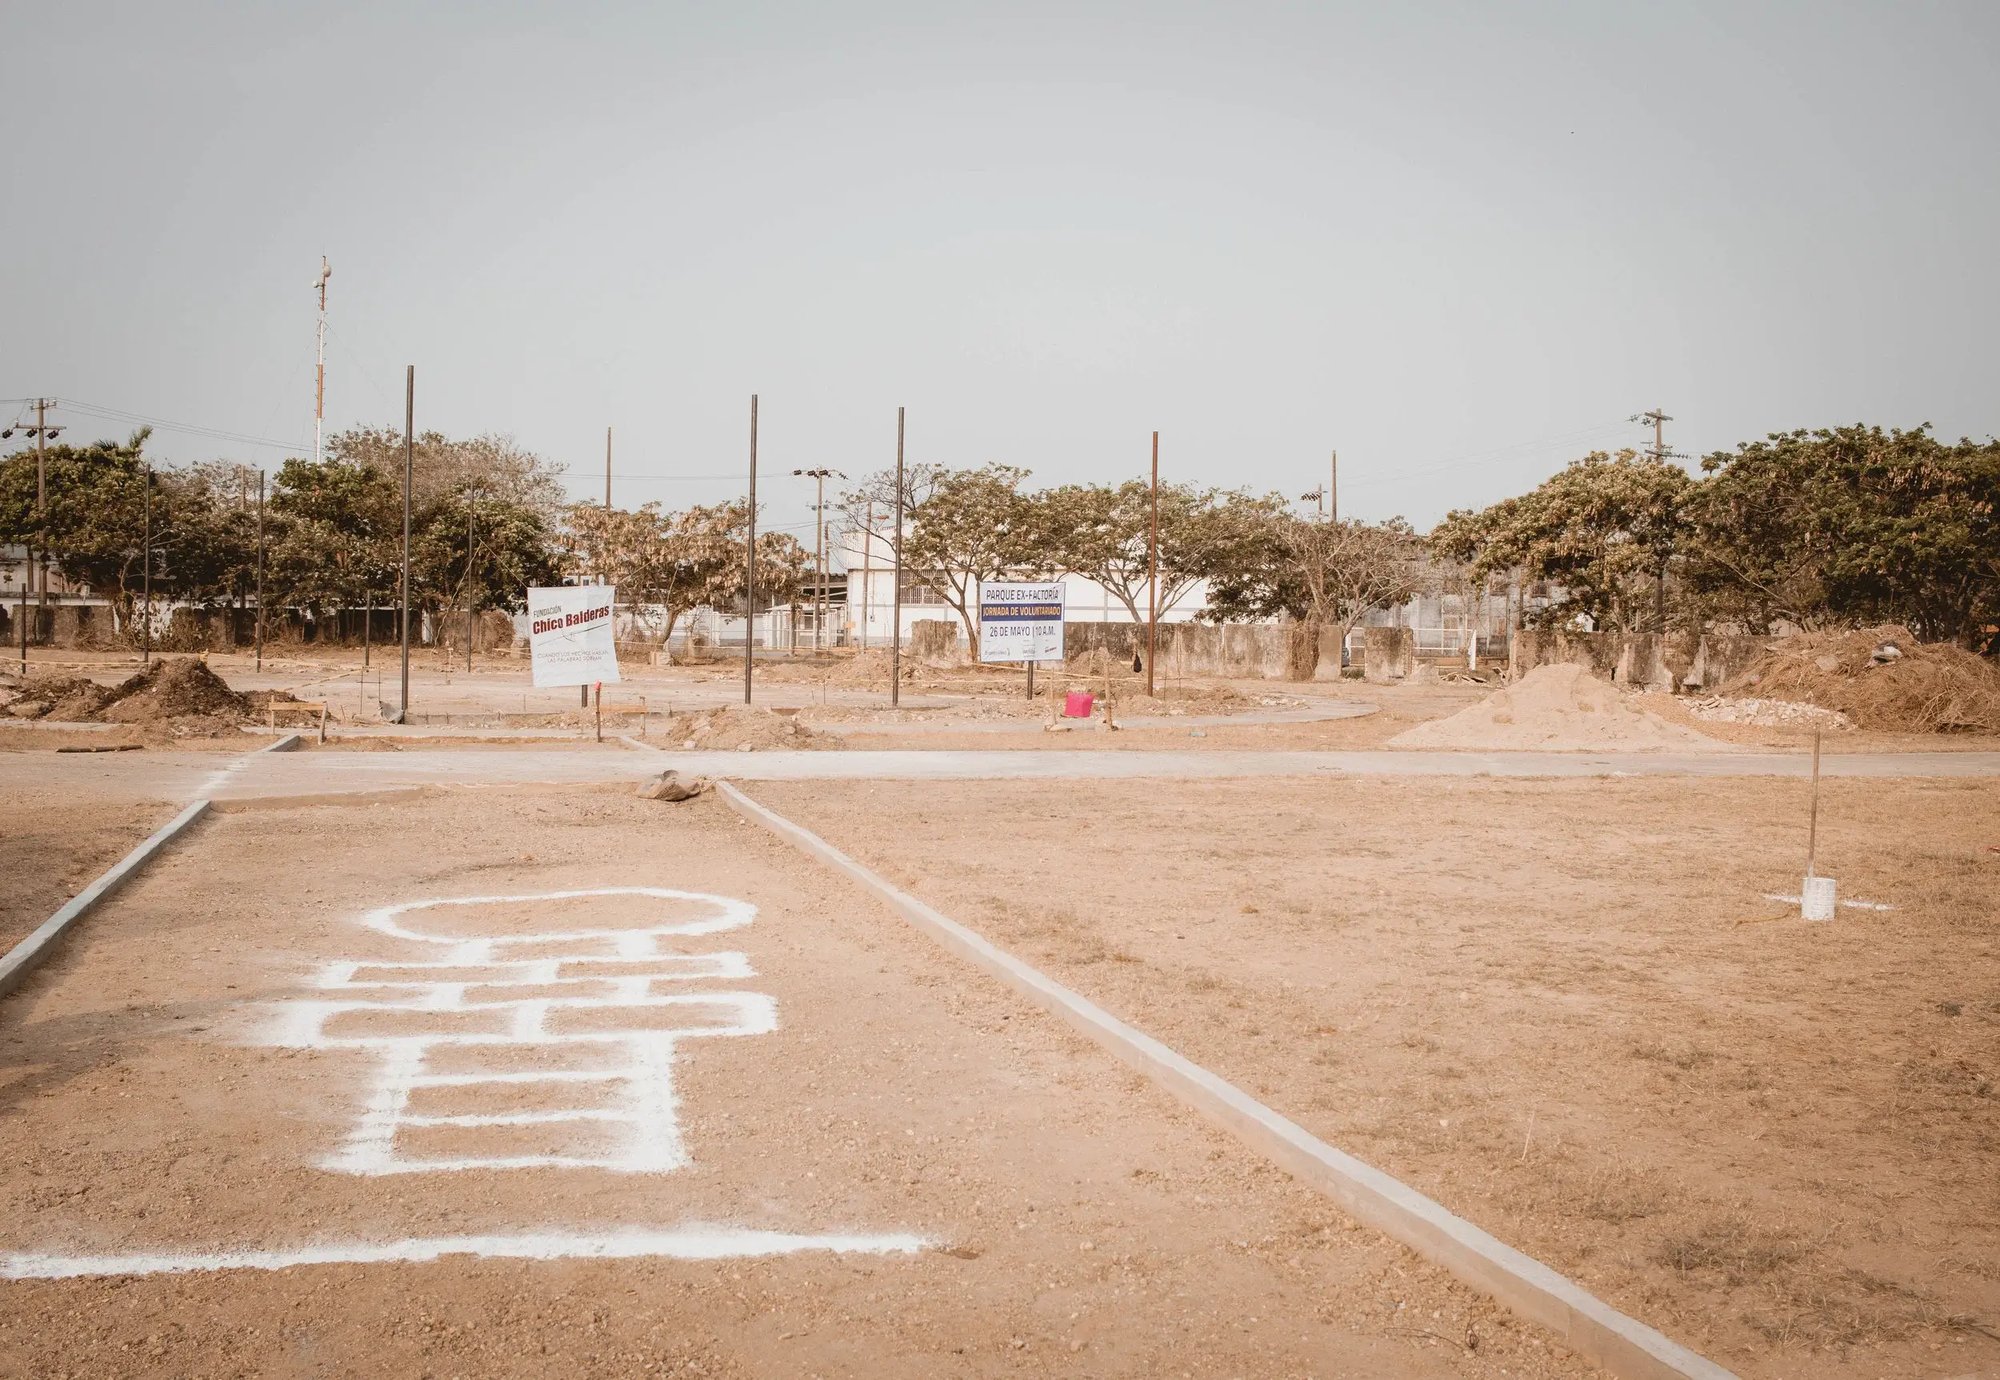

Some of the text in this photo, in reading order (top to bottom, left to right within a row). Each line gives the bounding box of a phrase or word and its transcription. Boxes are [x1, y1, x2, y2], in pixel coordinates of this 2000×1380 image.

[986, 587, 1058, 602] PARQUE EX-FACTORÍA
[534, 605, 562, 618] FUNDACIÓN
[983, 607, 1060, 616] JORNADA DE VOLUNTARIADO
[533, 605, 609, 634] Chico Balderas
[990, 627, 998, 637] 26
[999, 627, 1008, 636] DE
[1010, 626, 1030, 636] MAYO
